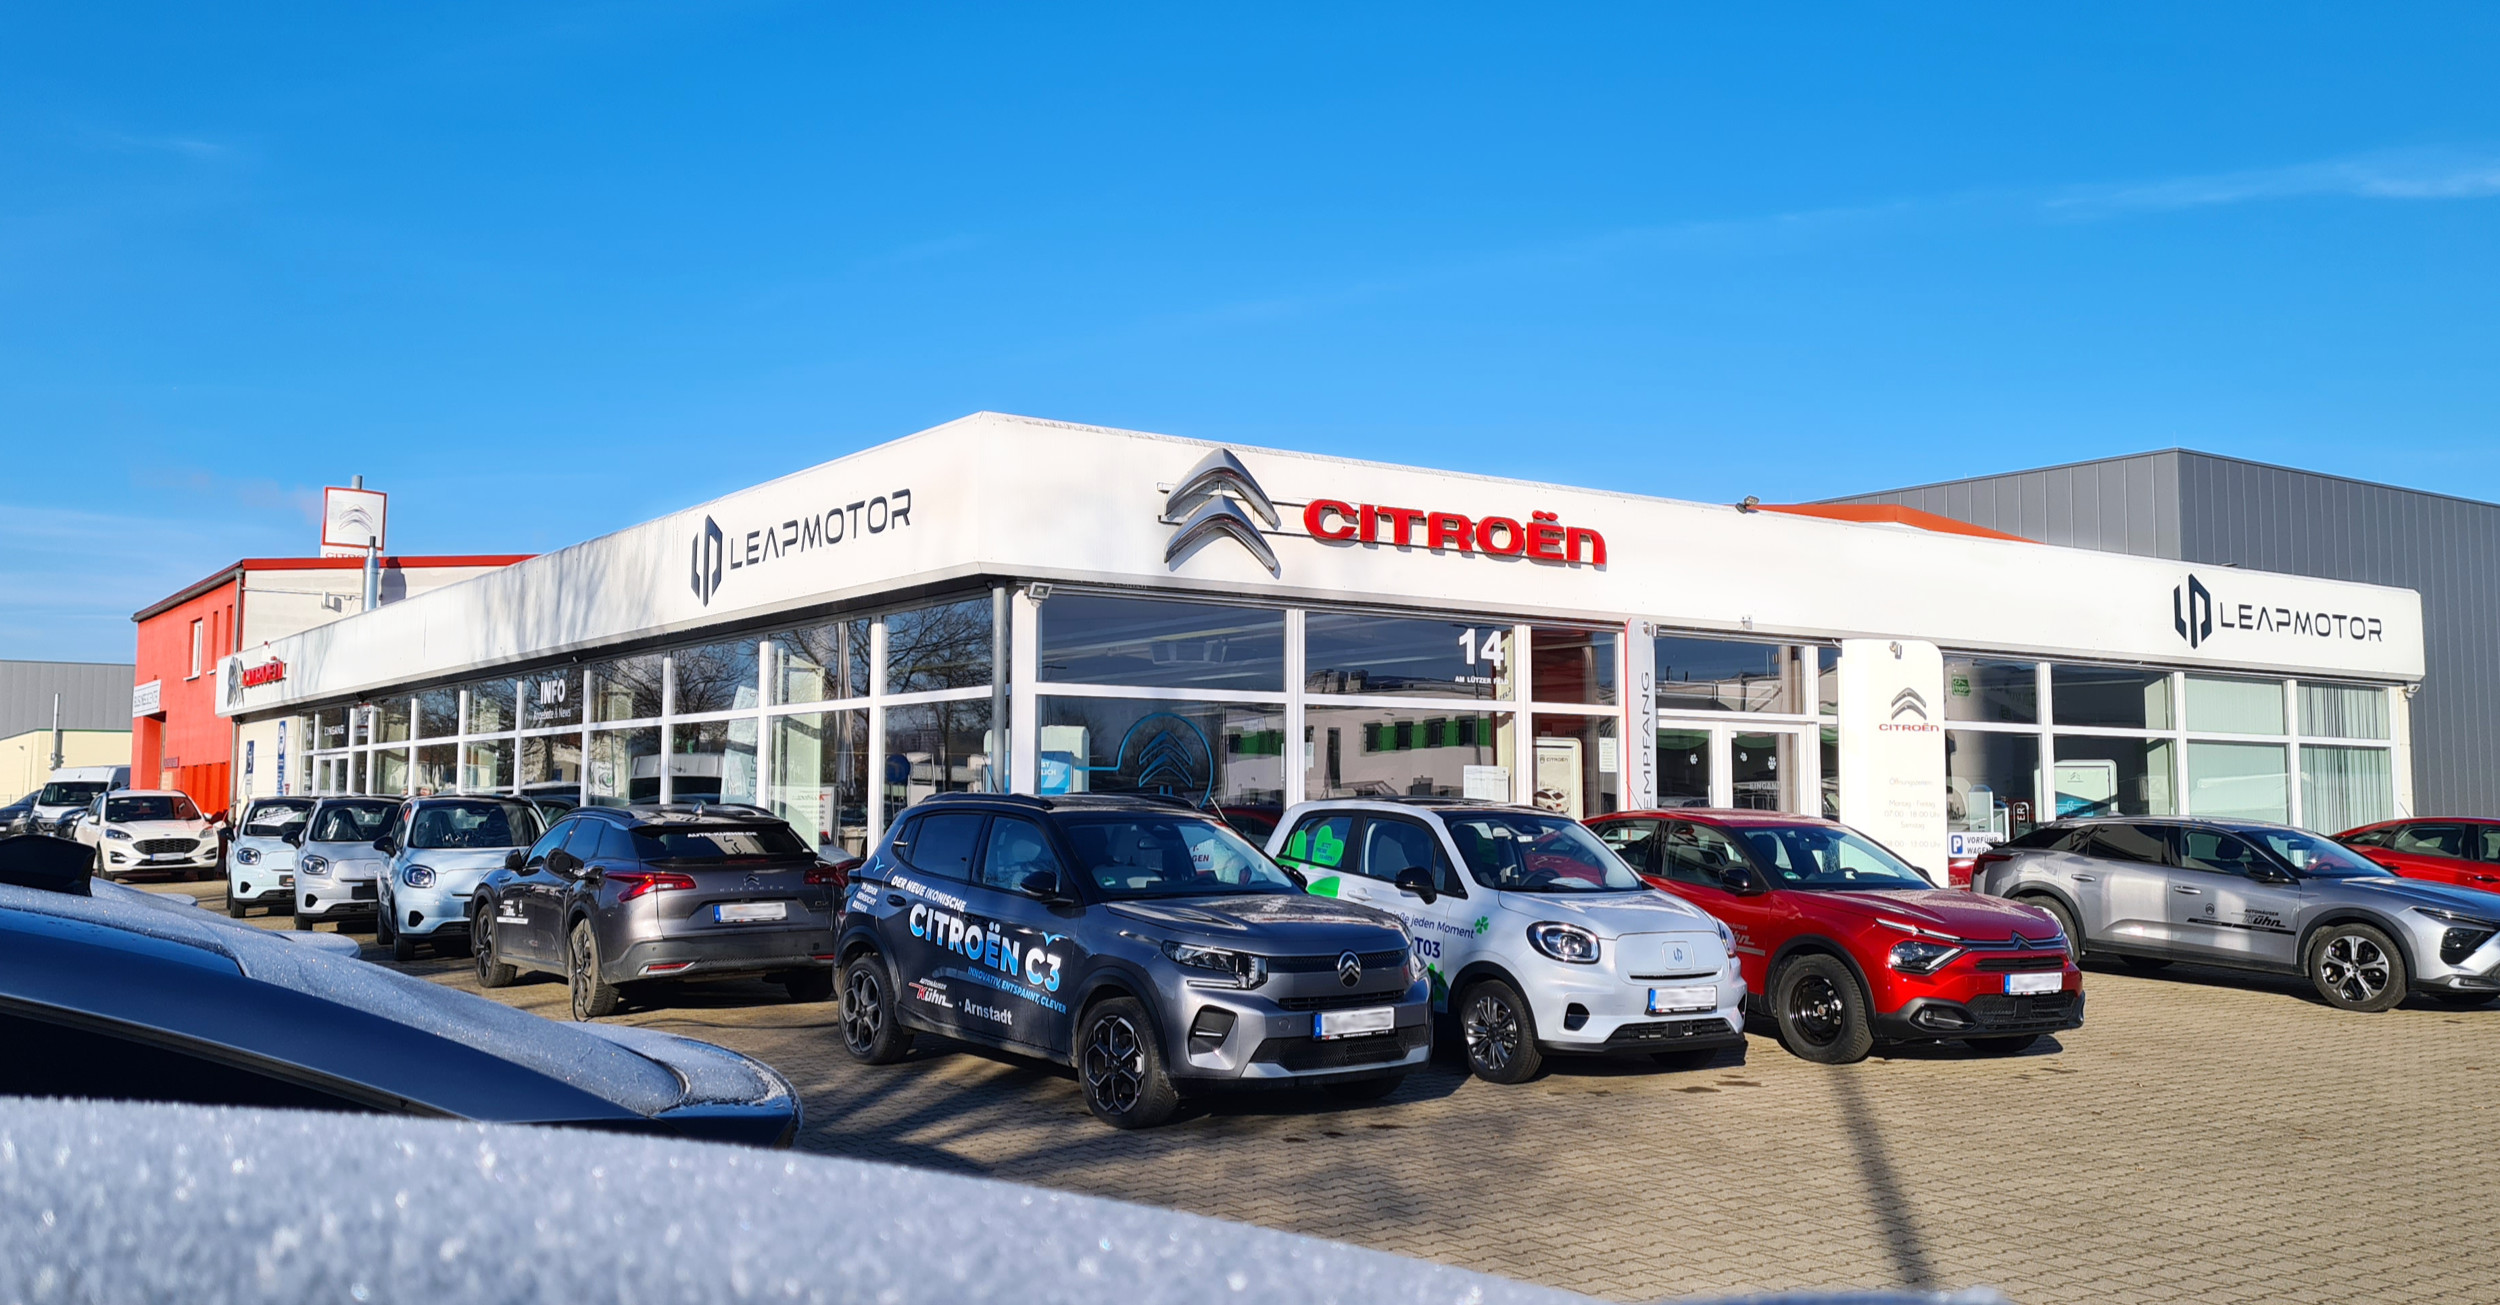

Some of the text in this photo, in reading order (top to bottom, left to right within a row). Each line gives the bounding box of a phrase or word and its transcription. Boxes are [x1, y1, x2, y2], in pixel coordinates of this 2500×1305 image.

[730, 488, 911, 570] LEAPMOTOR
[2220, 602, 2383, 642] LEAPMOTOR
[1459, 628, 1504, 667] 14
[540, 678, 566, 705] INFO
[1467, 676, 1491, 684] LÜTZER
[558, 707, 572, 717] News
[324, 724, 344, 737] EINGANG
[1641, 672, 1652, 810] EMPFANG
[1192, 854, 1209, 862] GEN
[891, 875, 967, 912] DER NEUE IKONISCHE
[1410, 914, 1435, 930] jeden
[1437, 921, 1475, 939] Moment
[909, 903, 1062, 993] CITROËN C3
[1414, 936, 1441, 959] T03
[910, 982, 953, 1008] Kühn
[919, 977, 947, 990] AUTOHÄUSER
[968, 966, 1067, 1015] INNOVATIV, ENTSPANNT, CLEVER
[964, 998, 1013, 1025] Arnstadt
